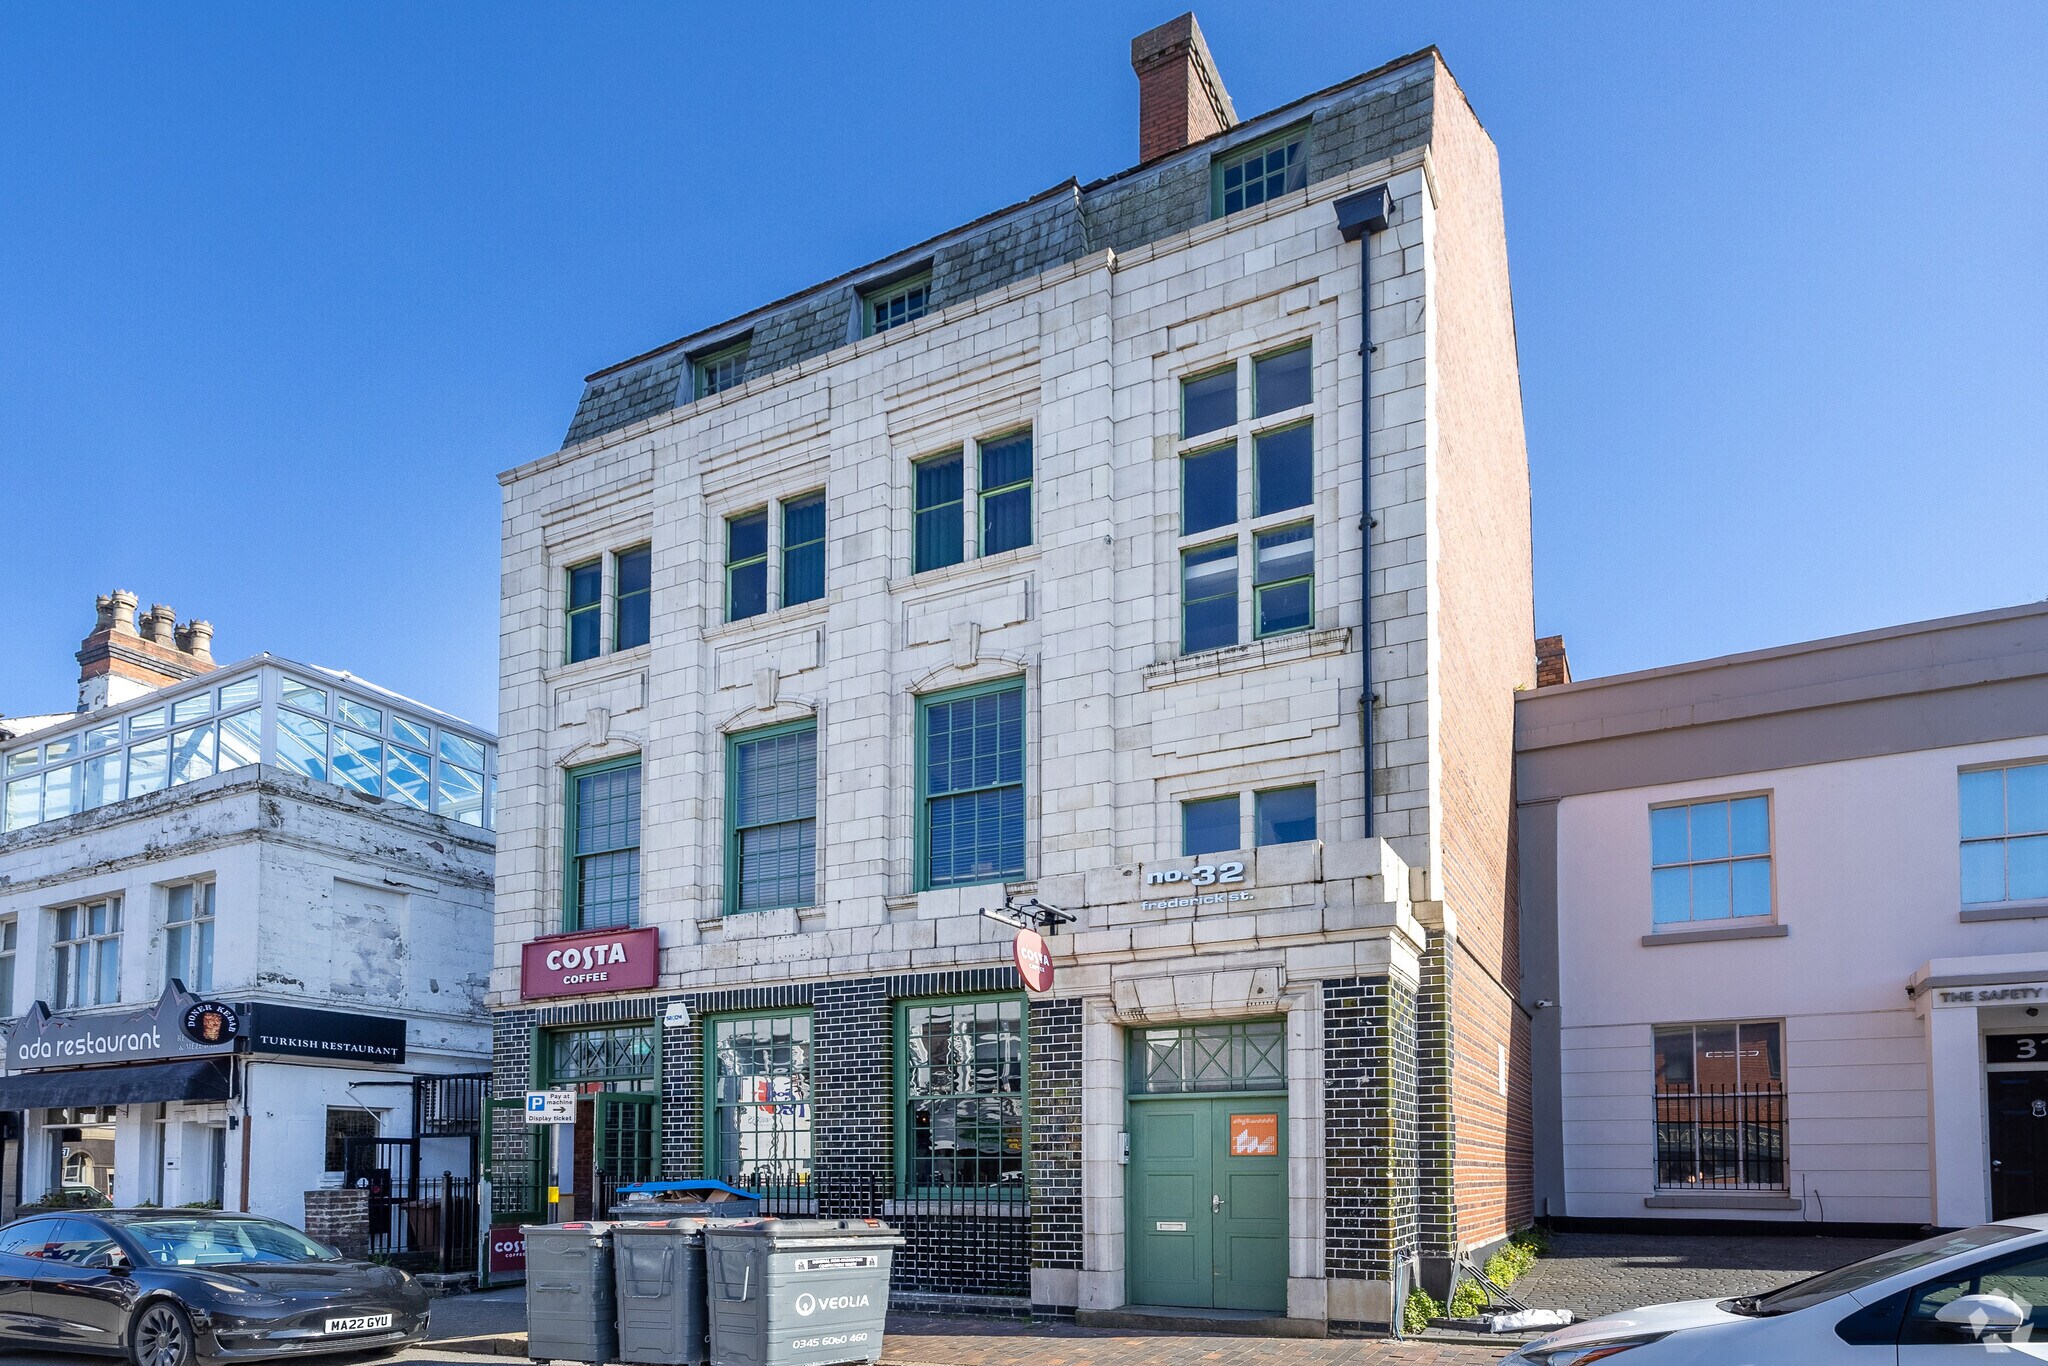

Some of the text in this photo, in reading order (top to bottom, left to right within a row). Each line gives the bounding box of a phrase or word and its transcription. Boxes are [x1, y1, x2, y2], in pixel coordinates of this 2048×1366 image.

[1141, 891, 1255, 911] frederick st.
[546, 942, 627, 971] COSTA
[1020, 946, 1050, 967] COSTA
[563, 971, 609, 985] COFFEE
[1940, 987, 2043, 1003] THE SAFETY
[187, 1004, 237, 1034] DONER KEBAB
[18, 1024, 161, 1060] ada restaurant
[260, 1035, 399, 1056] TURKISH RESTAURANT
[531, 1097, 543, 1110] P
[495, 1240, 526, 1253] COST
[817, 1294, 870, 1311] VEOLIA
[331, 1315, 388, 1331] MA22 GYU
[792, 1337, 820, 1349] 0345
[849, 1332, 868, 1342] 460
